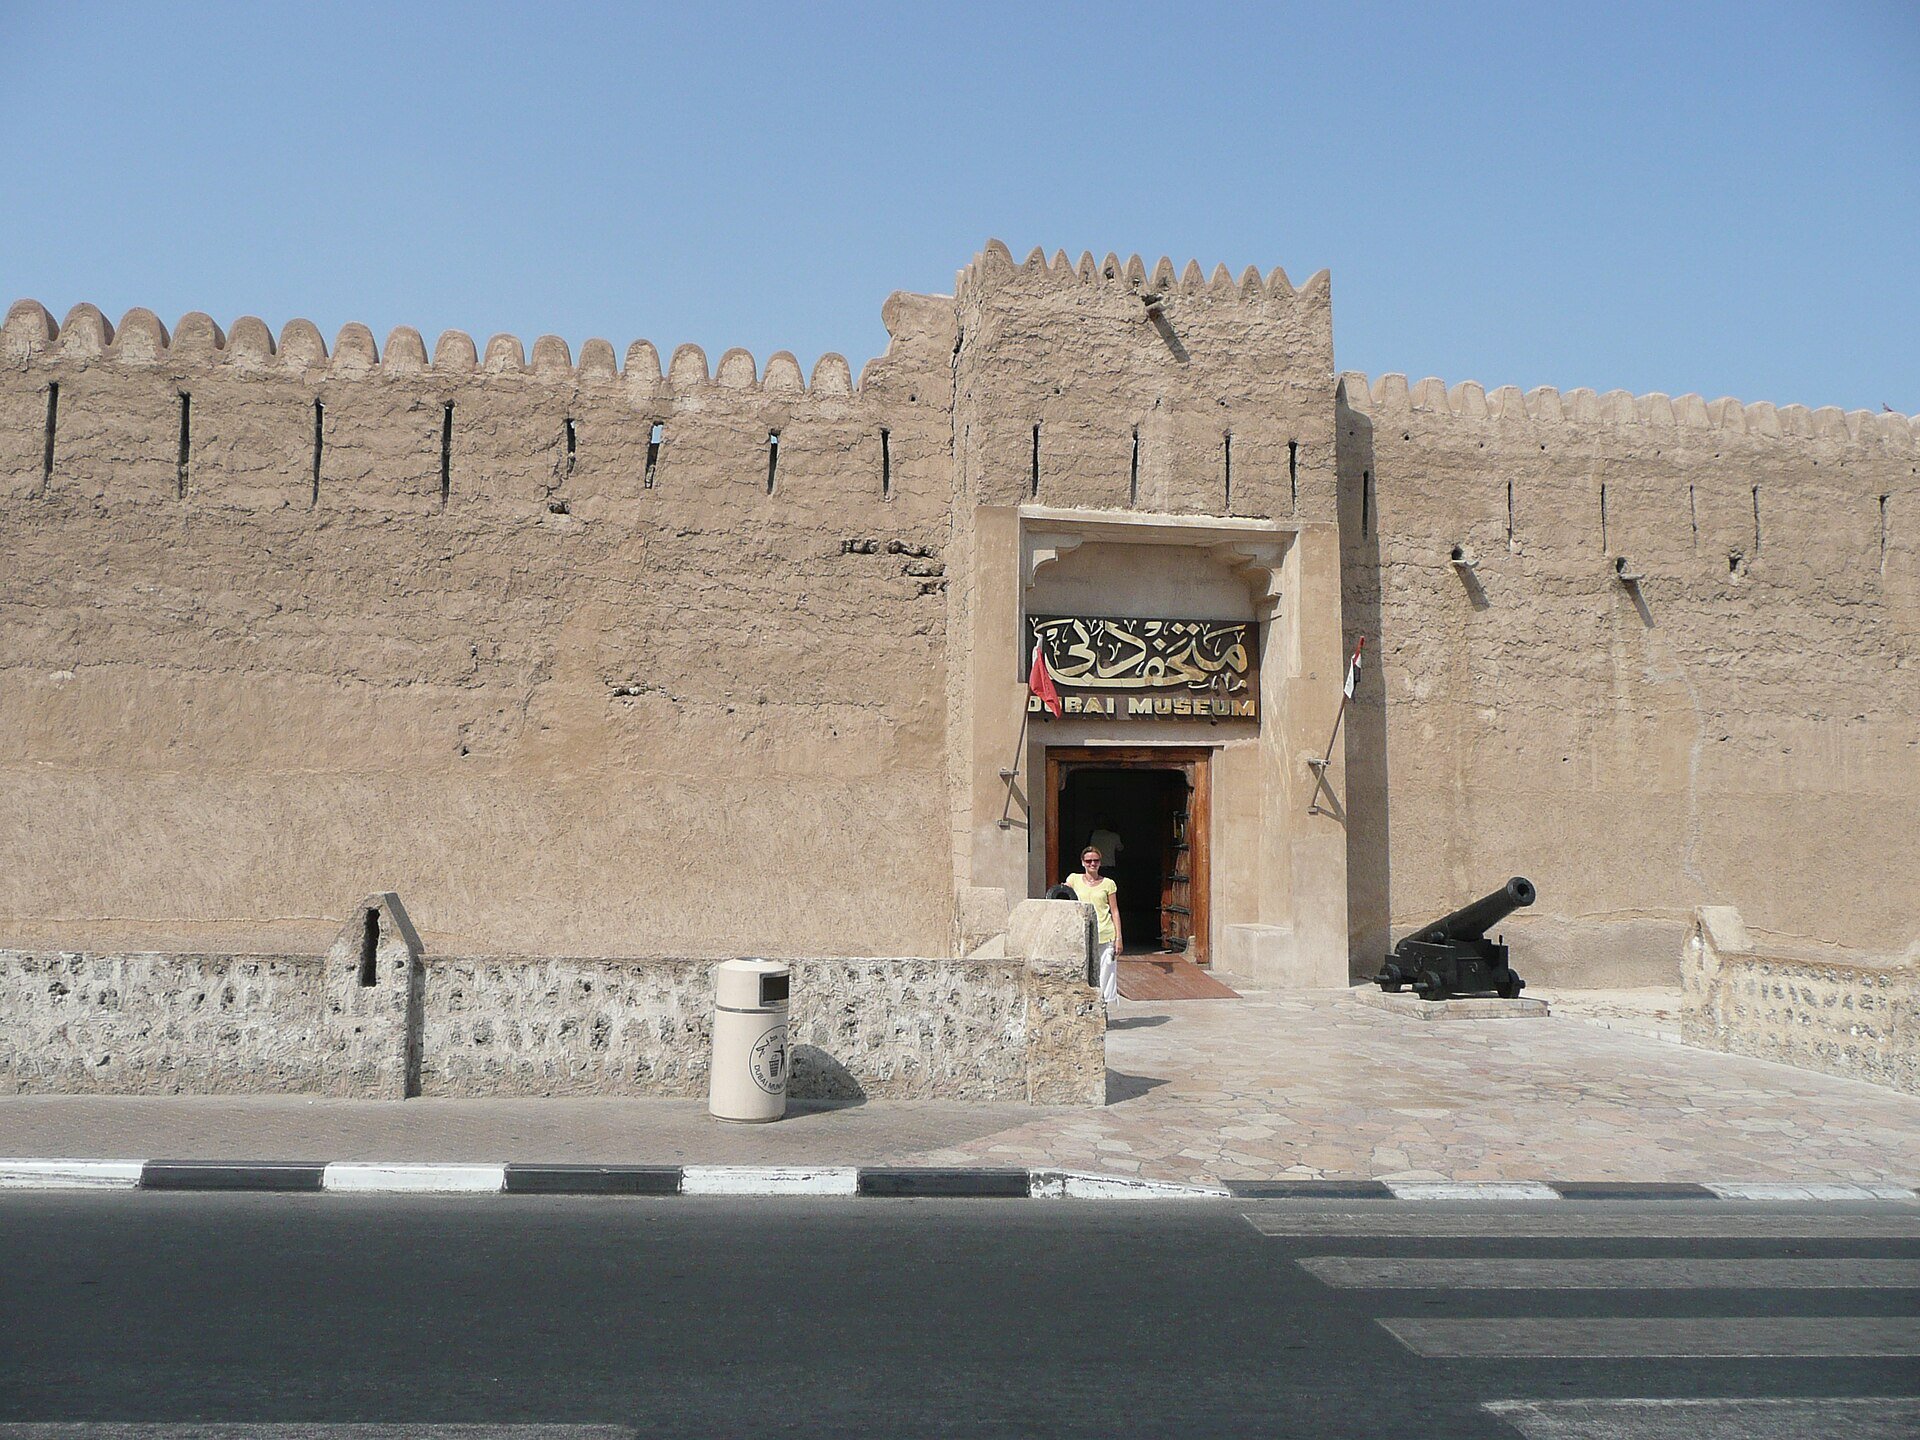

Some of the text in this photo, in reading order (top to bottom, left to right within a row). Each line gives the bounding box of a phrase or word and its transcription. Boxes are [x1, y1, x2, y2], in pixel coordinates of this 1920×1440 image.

[1045, 622, 1248, 688] متحف
[1128, 697, 1256, 716] MUSEUM
[754, 1064, 768, 1088] DUBAI
